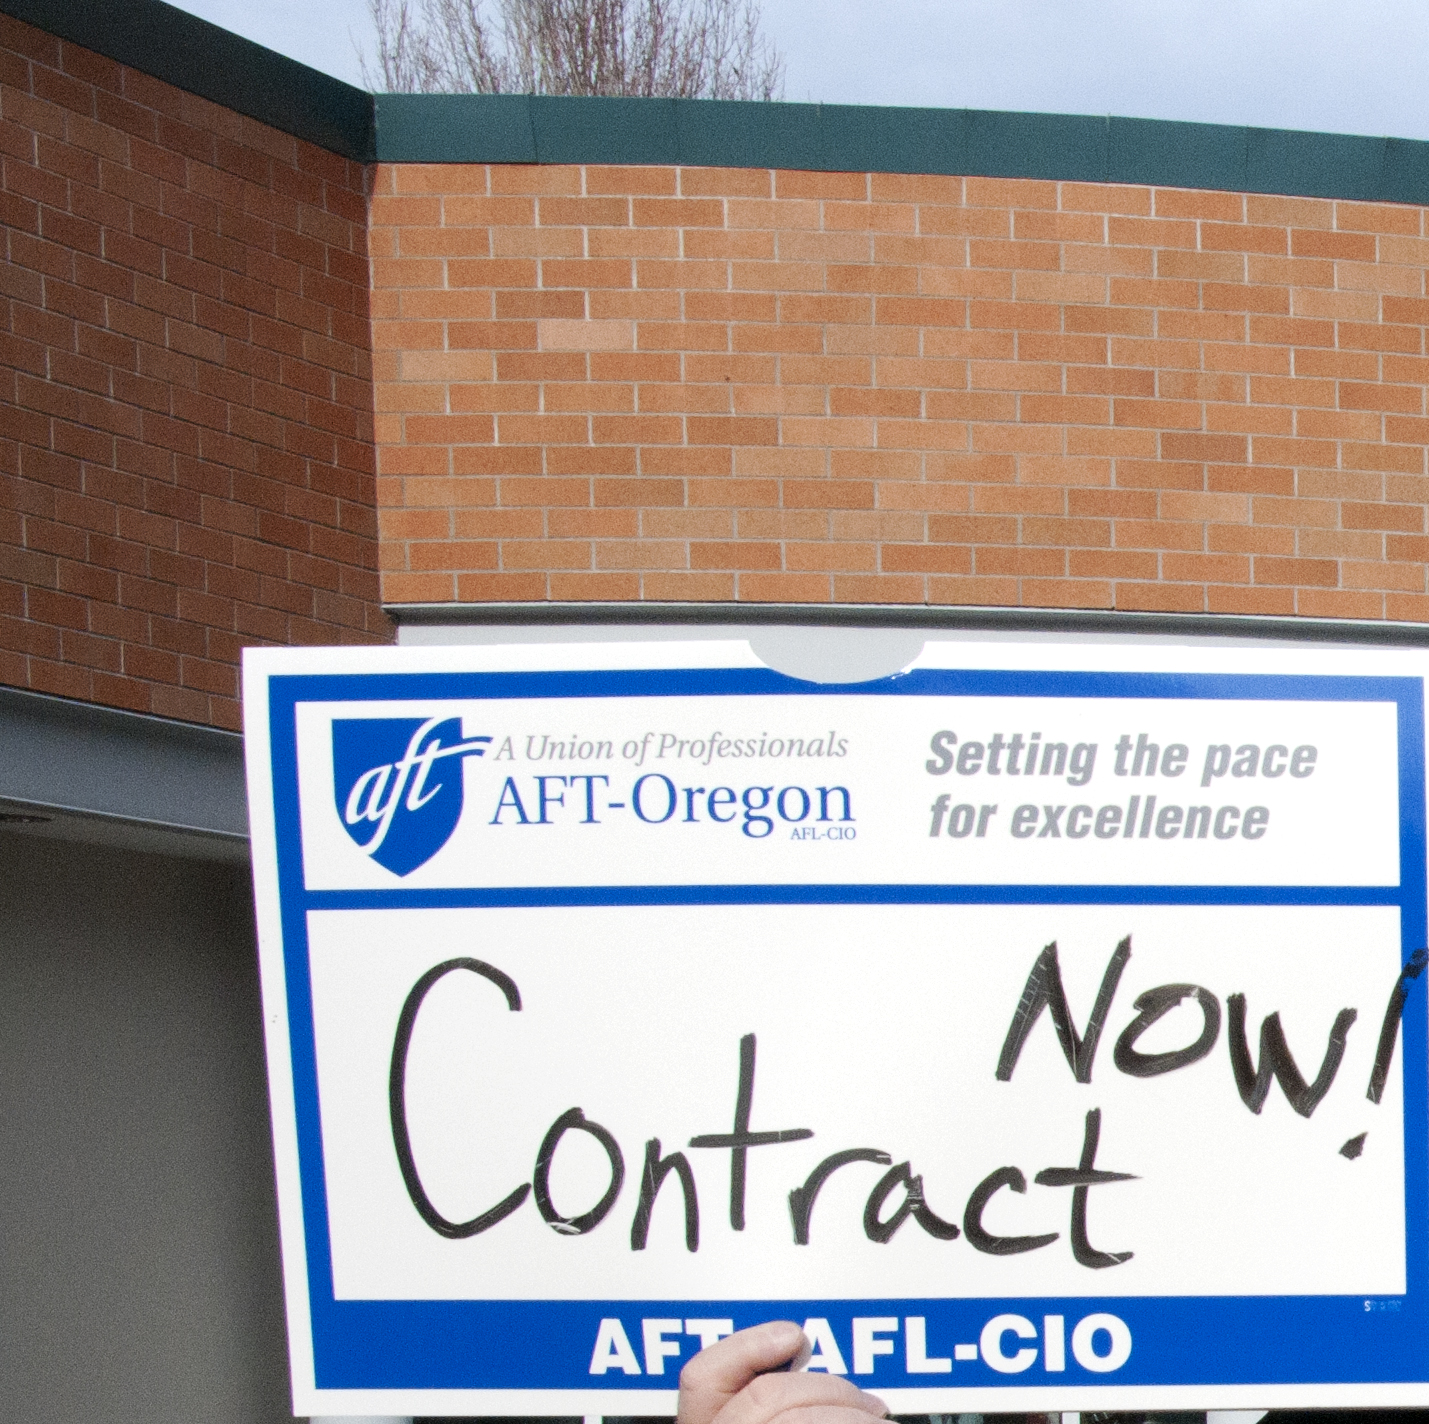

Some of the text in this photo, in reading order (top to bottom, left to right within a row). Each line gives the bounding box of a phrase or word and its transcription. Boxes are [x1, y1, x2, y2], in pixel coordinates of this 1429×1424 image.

[494, 730, 849, 766] A Union of Professionals
[926, 730, 1318, 787] Setting the pace
[344, 716, 494, 854] aft
[489, 772, 856, 838] AFT-Oregon
[790, 827, 857, 841] AFL-CIO
[929, 794, 1271, 840] for excellence
[388, 955, 1143, 1270] Contract
[798, 1313, 1134, 1378] AFL-CIO
